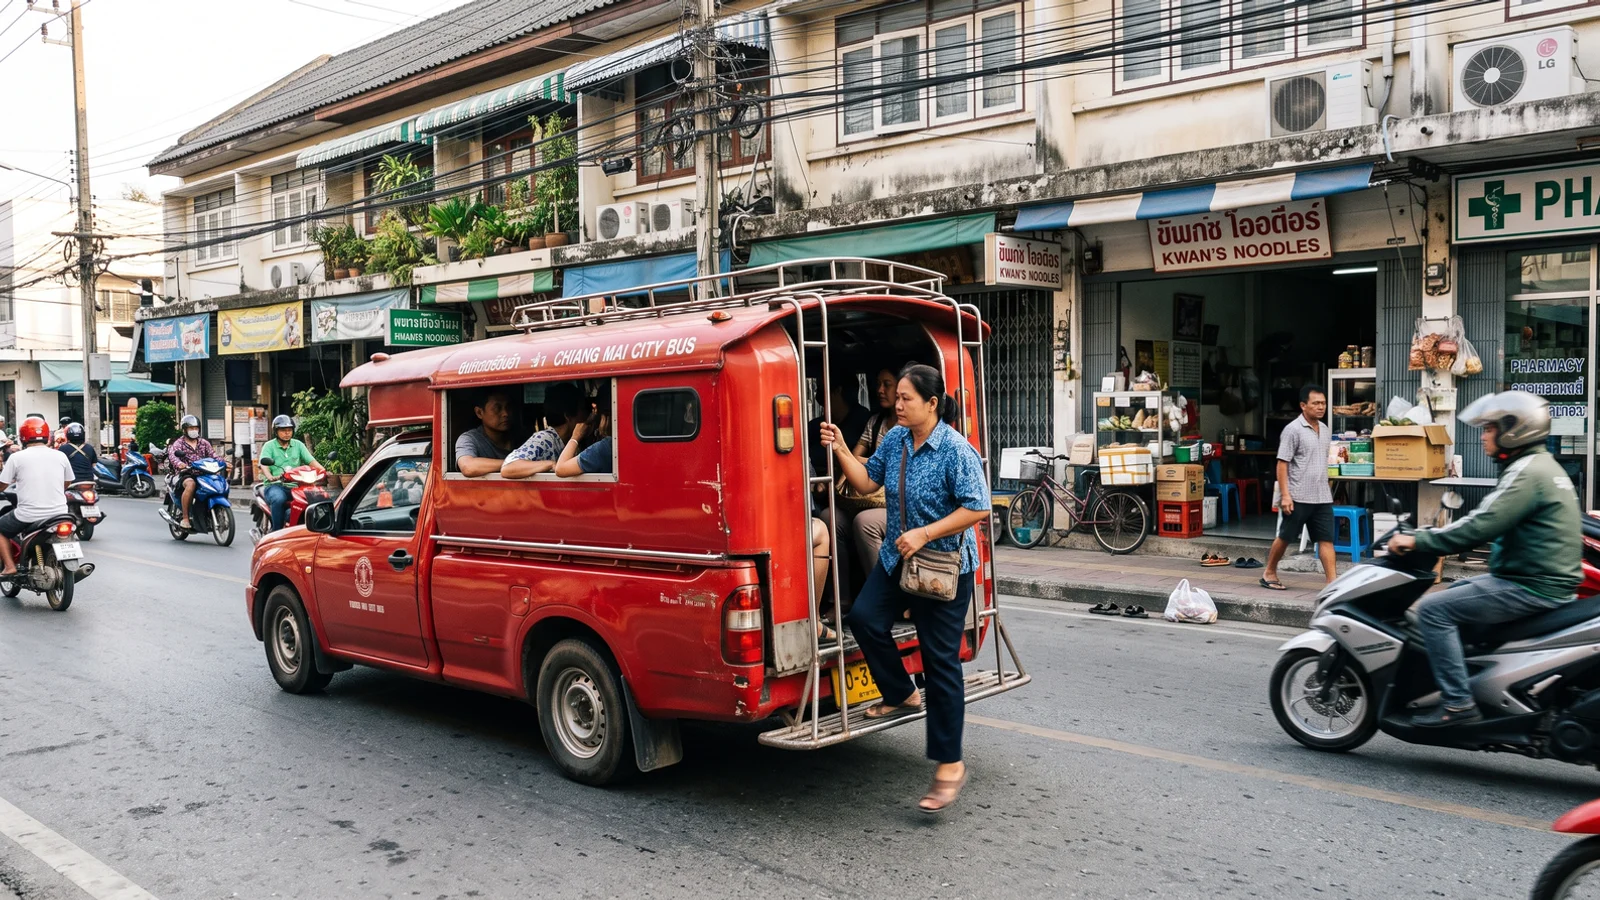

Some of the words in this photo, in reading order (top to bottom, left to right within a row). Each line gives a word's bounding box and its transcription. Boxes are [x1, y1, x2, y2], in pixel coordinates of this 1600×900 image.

[1538, 58, 1556, 70] LG
[1535, 175, 1600, 221] PH
[1162, 247, 1227, 266] KWAN'S
[1234, 238, 1320, 259] NOODLES
[999, 267, 1027, 280] KWAN'S
[1029, 270, 1060, 284] NOODLES
[553, 346, 602, 367] CHIANG
[602, 343, 630, 362] MAI
[630, 340, 666, 359] CITY
[665, 336, 698, 356] BUS
[1511, 358, 1586, 373] PHARMACY
[844, 666, 877, 692] 0-3
